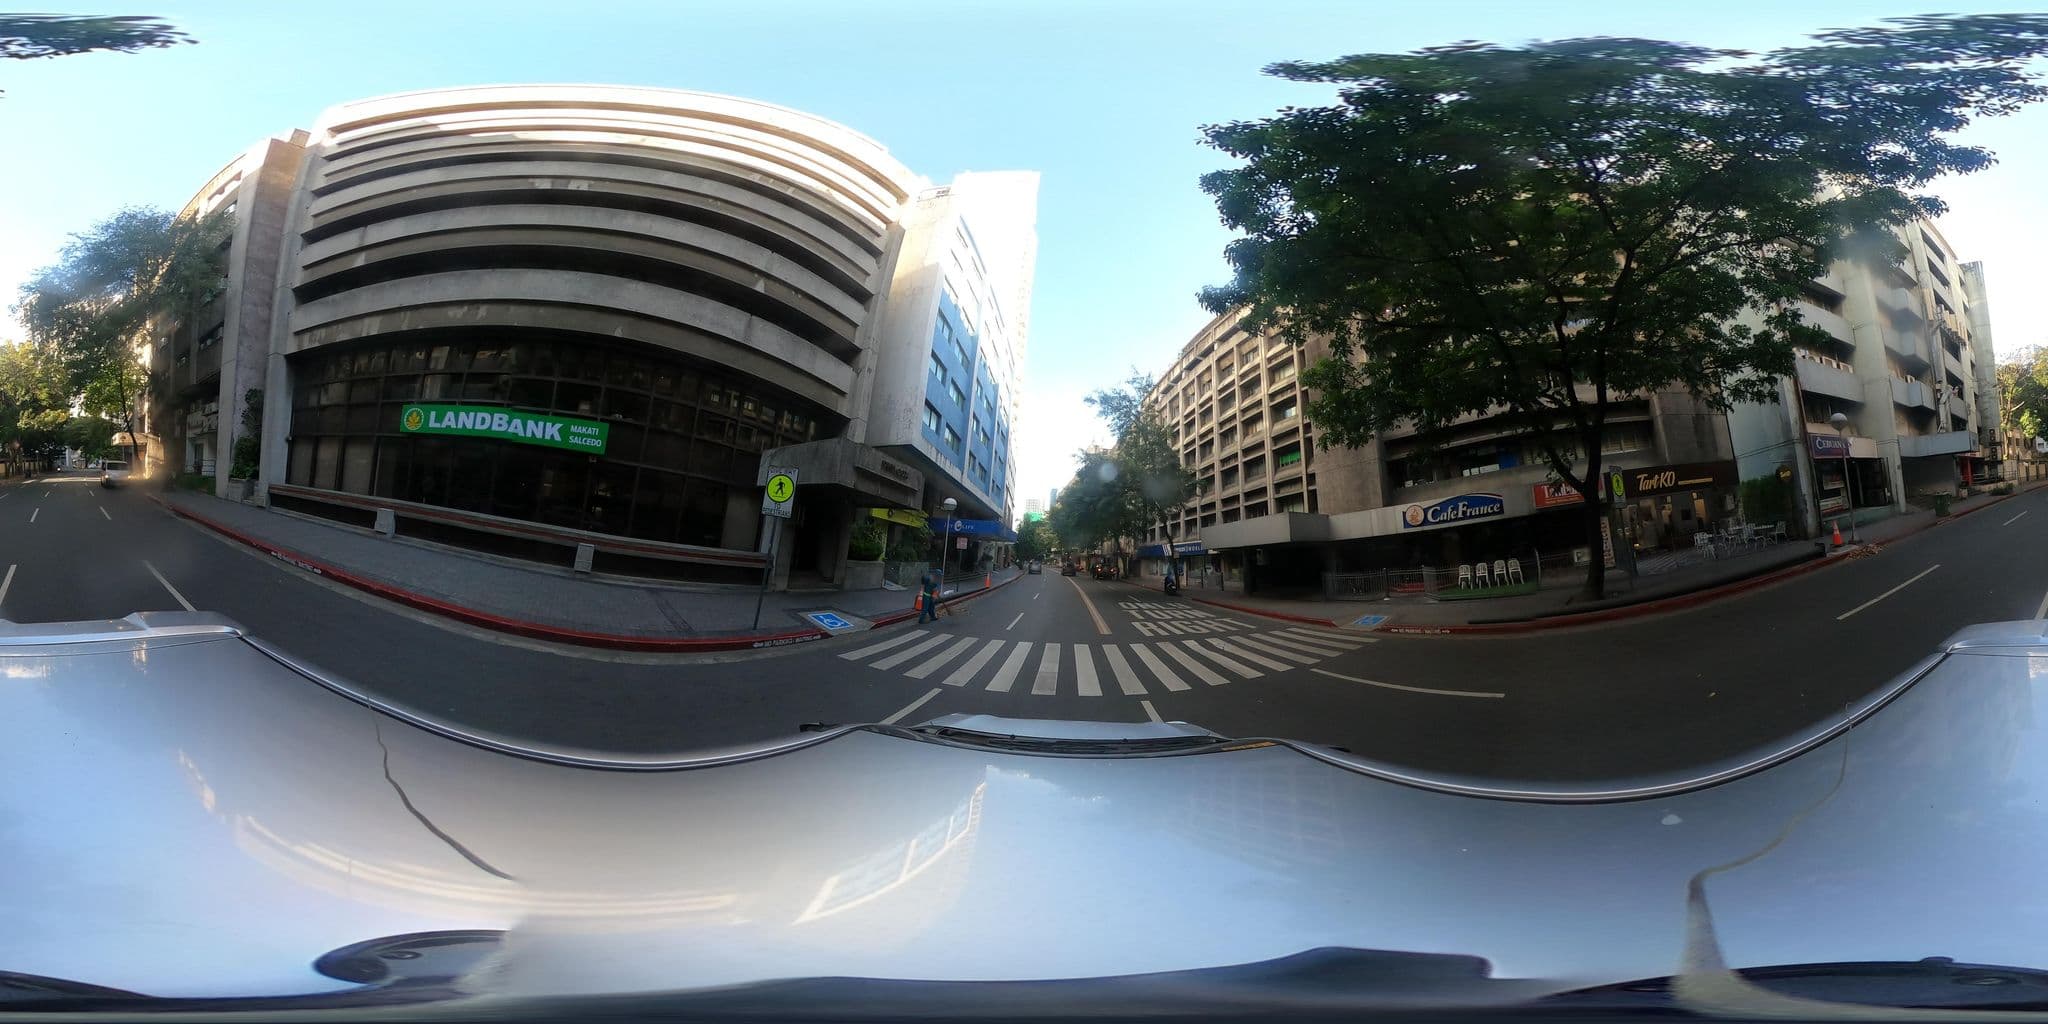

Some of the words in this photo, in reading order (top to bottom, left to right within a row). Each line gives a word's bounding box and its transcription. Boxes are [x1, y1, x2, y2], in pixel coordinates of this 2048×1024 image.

[428, 411, 563, 441] LANDBANK
[570, 424, 599, 436] MAKATI
[568, 435, 602, 447] SALCEDO
[1122, 609, 1216, 619] TURN
[1131, 618, 1256, 636] RIGHT
